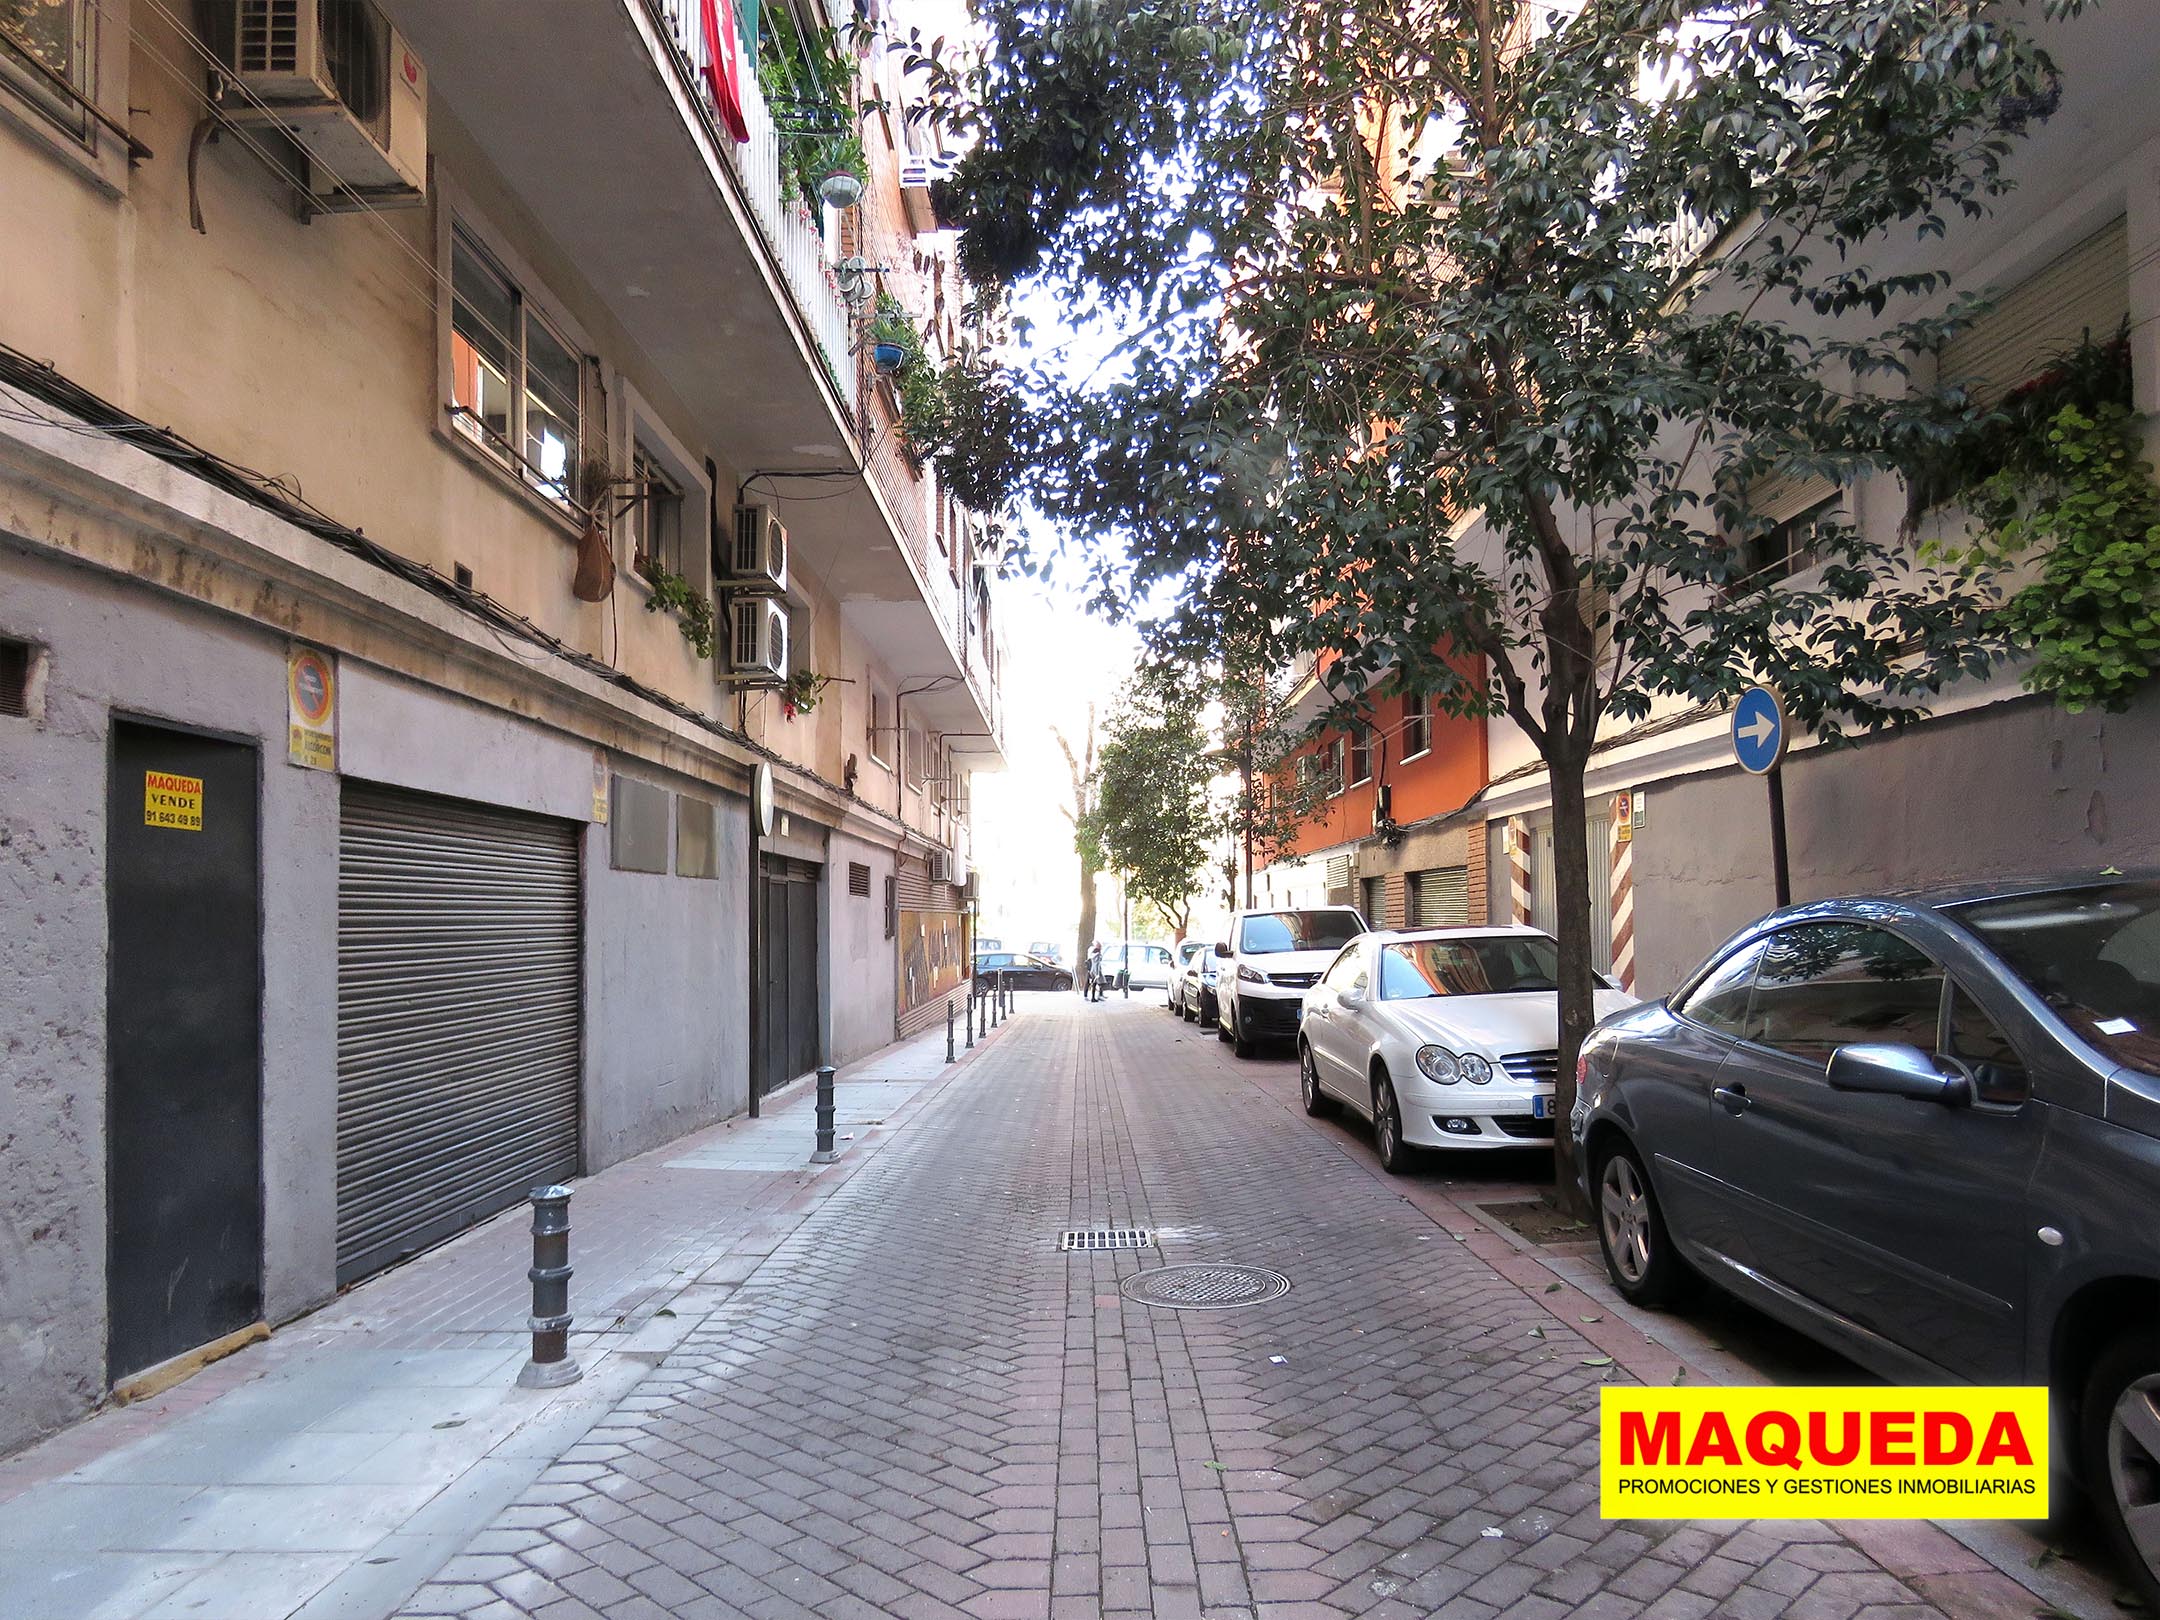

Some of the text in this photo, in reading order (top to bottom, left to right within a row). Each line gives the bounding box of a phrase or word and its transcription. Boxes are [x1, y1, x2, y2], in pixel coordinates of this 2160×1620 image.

[148, 774, 202, 794] MAQUEDA
[151, 793, 196, 810] VENDE
[146, 810, 201, 827] 91 643 49 89
